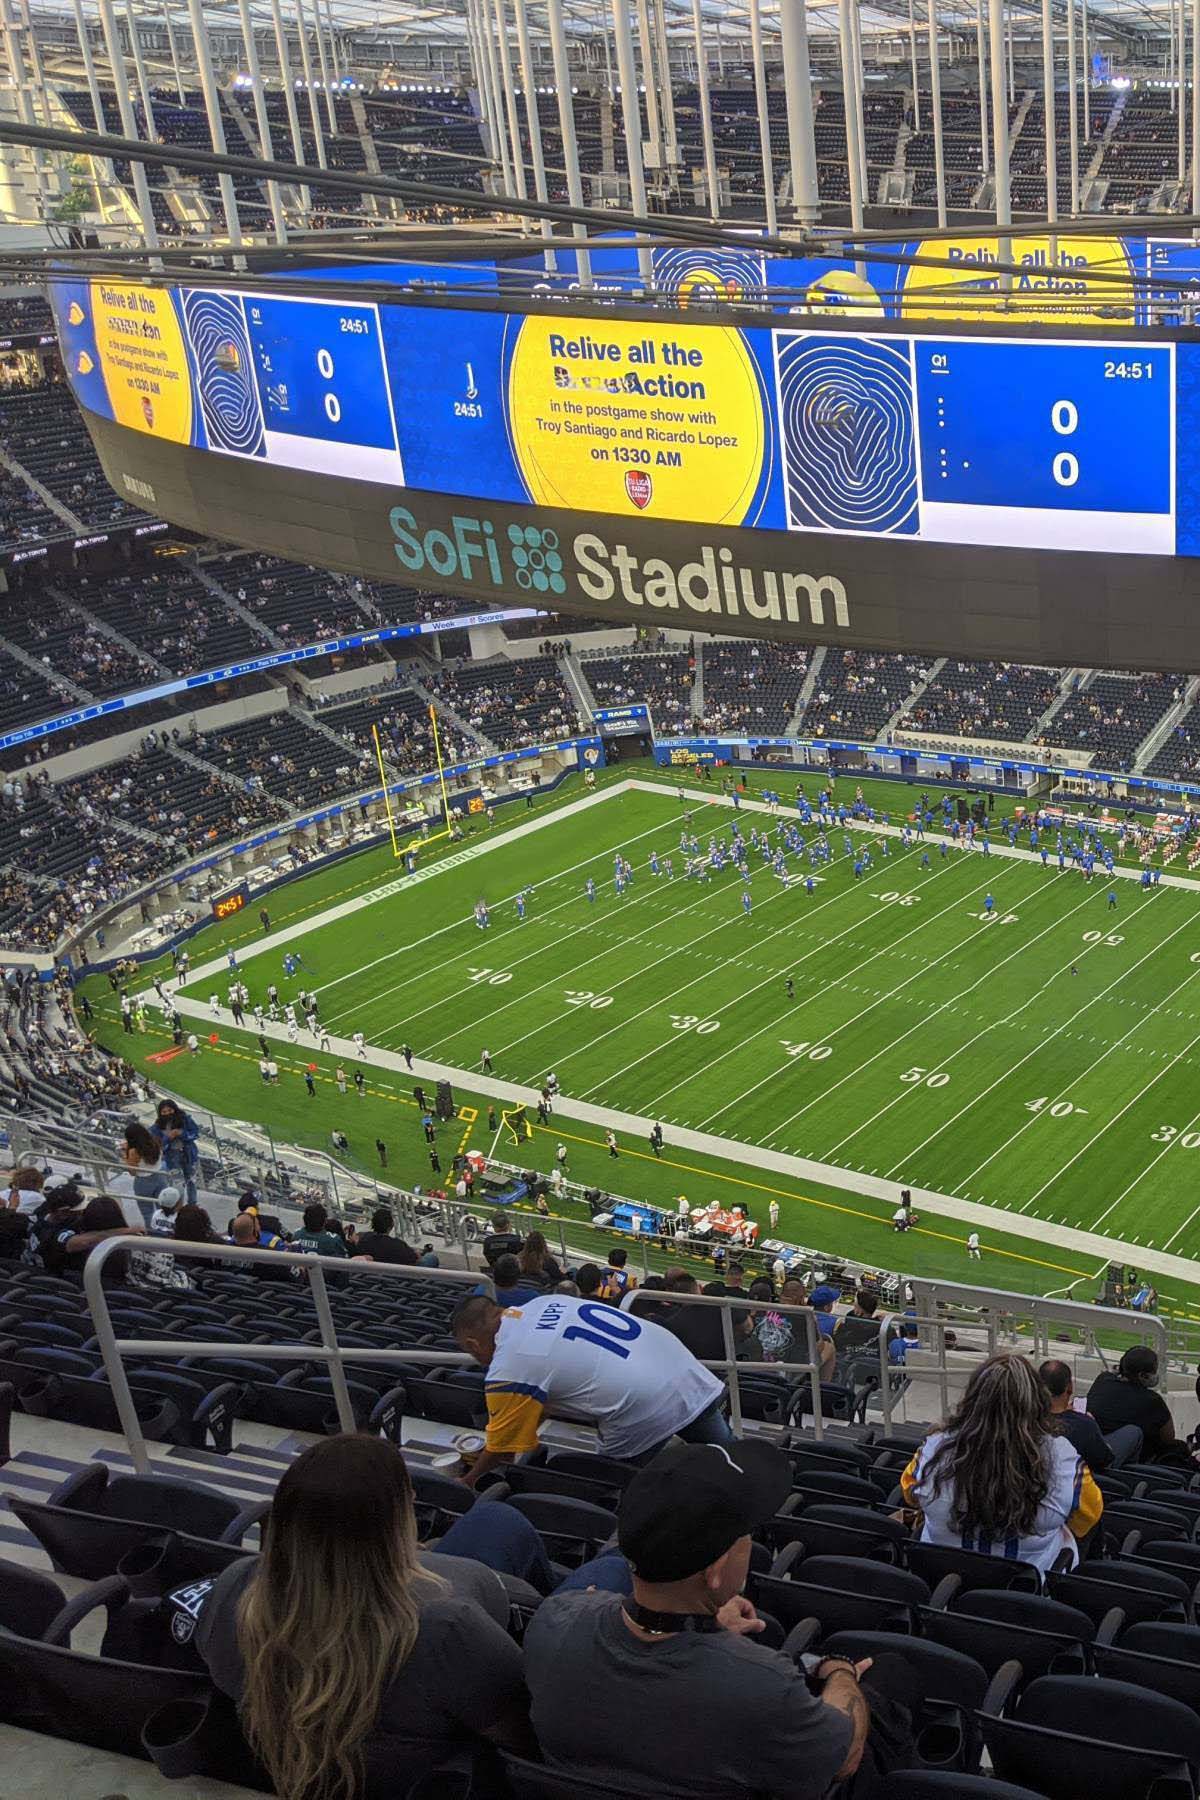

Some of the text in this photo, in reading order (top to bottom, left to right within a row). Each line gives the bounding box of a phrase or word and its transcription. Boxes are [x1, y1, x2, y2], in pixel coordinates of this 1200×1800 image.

[949, 247, 1014, 264] Reliv
[100, 286, 156, 314] Relive all the
[340, 318, 369, 334] 24:51
[550, 334, 703, 367] Relive all the
[931, 354, 948, 367] Q1
[317, 349, 334, 379] 0
[1104, 362, 1153, 379] 24:51
[324, 393, 341, 423] 0
[454, 403, 483, 418] 24:51
[550, 400, 717, 425] in the postgame show with
[1051, 399, 1079, 435] 0
[536, 418, 738, 449] Troy Santiago and Ricardo Lopez
[590, 447, 682, 467] on 1330 AM
[1052, 451, 1080, 487] 0
[389, 506, 504, 585] SoFi
[572, 533, 850, 628] Stadium
[432, 612, 504, 630] Week Scores
[217, 895, 242, 917] 24:51
[467, 967, 513, 985] 10
[567, 991, 614, 1009] 20
[671, 1015, 721, 1034] 30
[785, 1041, 833, 1061] 40
[899, 1066, 950, 1089] 50
[1024, 1096, 1075, 1118] 40
[535, 1302, 568, 1331] KUPP
[562, 1303, 642, 1360] 10
